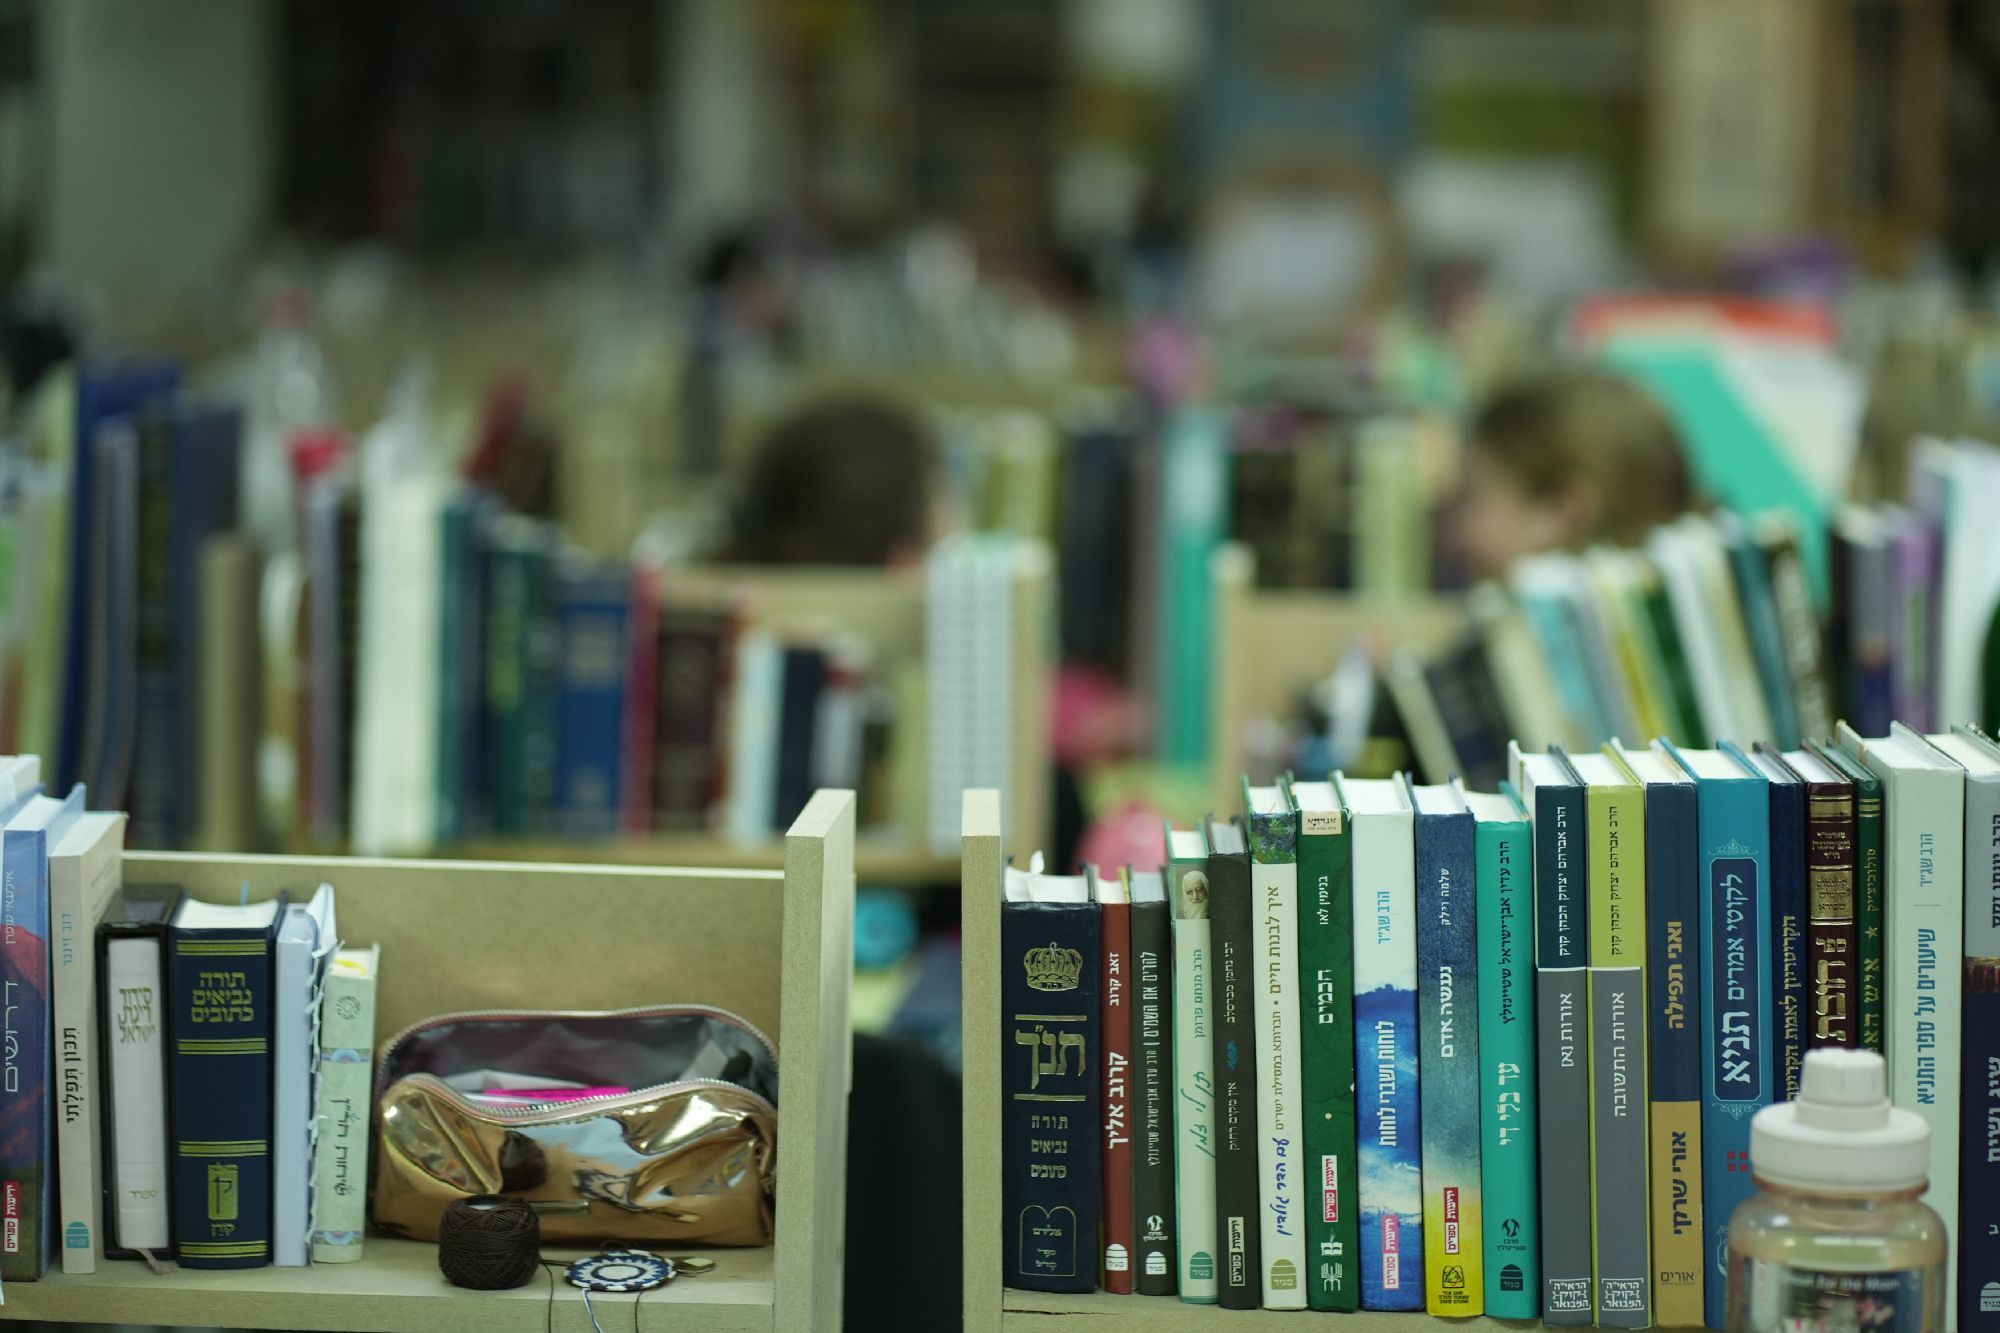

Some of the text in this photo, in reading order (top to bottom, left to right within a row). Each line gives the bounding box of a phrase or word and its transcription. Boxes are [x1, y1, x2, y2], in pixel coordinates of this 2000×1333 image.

[1498, 841, 1510, 865] הרב
[1919, 833, 1934, 888] הרב שג"ר
[1315, 875, 1331, 925] בנימין לאו
[1439, 868, 1452, 926] שלמה וילק
[1499, 867, 1513, 894] עדין
[1557, 806, 1570, 957] הרב אברהם יצחק הכהן קוק
[1609, 806, 1622, 956] הרב אברהם יצחק הכהן קוק
[1265, 886, 1282, 995] איך לבנות חיים
[1376, 891, 1391, 945] הרב שג"ר
[1782, 915, 1803, 990] הקריטריון
[1815, 937, 1847, 953] ספר
[192, 989, 254, 1006] נביאים
[199, 971, 246, 988] תורה
[1107, 952, 1122, 1007] זאב קרוב
[1140, 951, 1159, 1038] להרים את השמים
[1192, 949, 1207, 1039] הרב מנחם פרומן
[1223, 941, 1237, 1024] רבי נחמן מברסלב
[1316, 968, 1334, 1025] חכמים
[1499, 968, 1516, 1025] שטיינזלץ
[1664, 921, 1684, 1029] ואני תפילה
[1719, 874, 1752, 1084] לקוטי אמרים תניא
[1863, 958, 1881, 1003] איש
[5, 980, 19, 1093] דרושים
[191, 1006, 255, 1023] כתובים
[1439, 966, 1454, 1058] נעשה אדם
[1559, 992, 1573, 1042] אורות
[1779, 995, 1799, 1040] לאמת
[1913, 928, 1937, 1105] שיעורים על ספר התניא
[1146, 1050, 1158, 1065] הרב
[1146, 1068, 1159, 1085] עדין
[1270, 1011, 1286, 1131] חברותא במסילת ישרים
[1611, 991, 1627, 1117] אורות התשובה
[1104, 1052, 1129, 1150] קרוב אליך
[1180, 1088, 1207, 1113] לי
[1227, 1081, 1239, 1096] אין
[1375, 1020, 1397, 1148] לוחות ושברי לוחות
[1496, 1062, 1521, 1146] עד בלי די
[1030, 1139, 1068, 1154] נביאים
[1031, 1115, 1068, 1130] תורה
[1227, 1127, 1240, 1151] רחוק
[1030, 1164, 1068, 1179] כתובים
[1146, 1131, 1161, 1167] שטיינזלץ
[1269, 1136, 1293, 1236] עם הדר גולדין
[1324, 1191, 1336, 1220] ספרים
[1671, 1131, 1692, 1235] אורי שרקי
[5, 1220, 16, 1249] ספרים
[1445, 1224, 1457, 1251] ספרים
[1231, 1254, 1243, 1282] ספרים
[1384, 1256, 1397, 1286] ספרים
[1660, 1271, 1695, 1282] אורים
